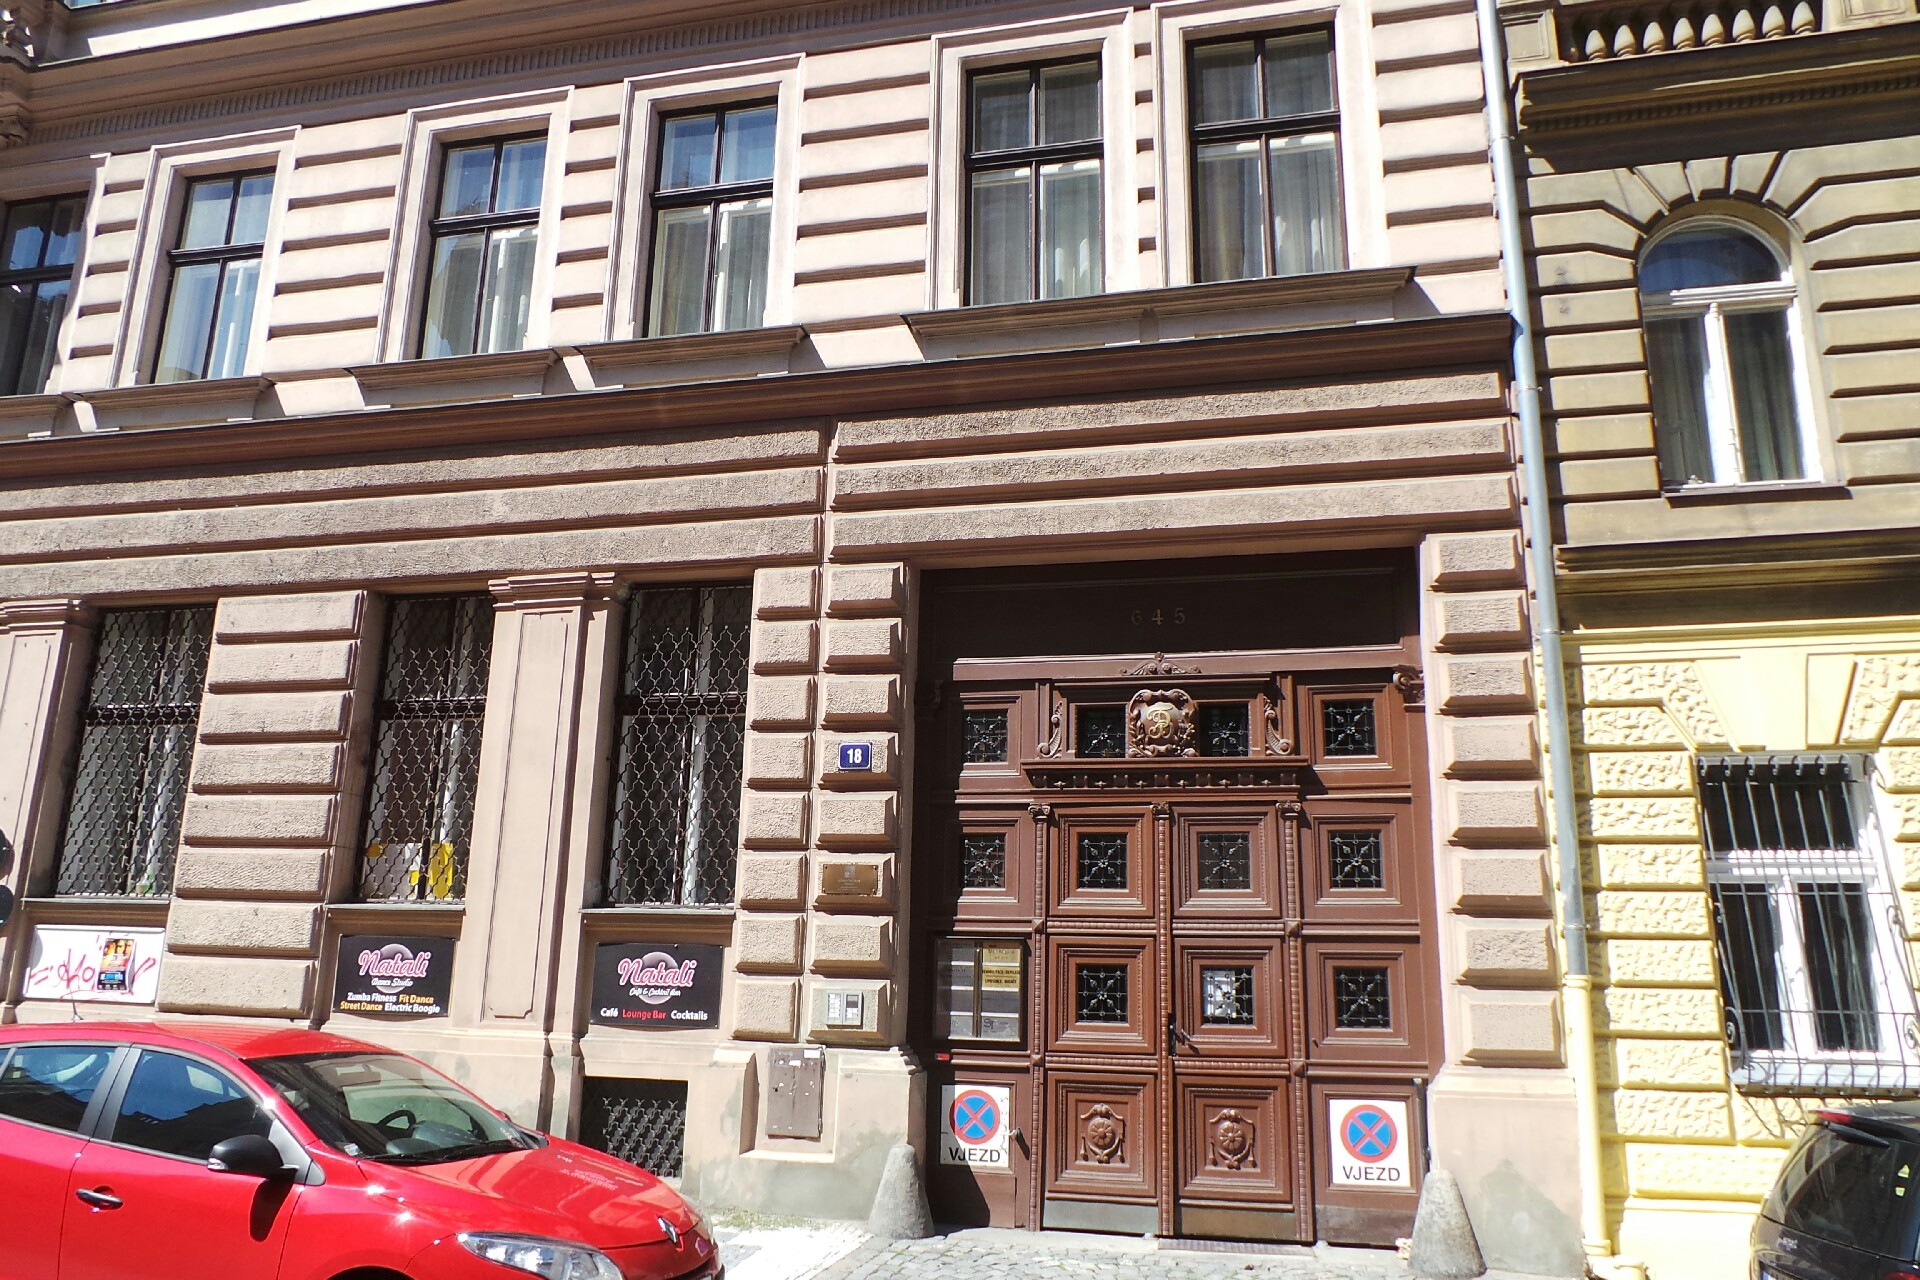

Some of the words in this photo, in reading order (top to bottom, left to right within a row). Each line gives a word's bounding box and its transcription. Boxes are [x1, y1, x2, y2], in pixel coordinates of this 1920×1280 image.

[846, 748, 862, 764] 18
[358, 950, 431, 978] Natali
[617, 958, 697, 987] Natali
[347, 992, 371, 1001] Zumba
[371, 993, 397, 1003] Fitness
[398, 994, 409, 1003] Fit
[410, 995, 434, 1004] Dance
[340, 1001, 361, 1010] Street
[361, 1002, 383, 1011] Dance
[384, 1003, 413, 1012] Electric
[413, 1004, 441, 1014] Boogie
[600, 1007, 619, 1017] Café
[622, 1009, 651, 1020] Lounge
[652, 1010, 667, 1019] Bar
[670, 1010, 708, 1020] Cocktails
[949, 1146, 1001, 1163] VJEZD
[1342, 1165, 1401, 1182] VJEZD
